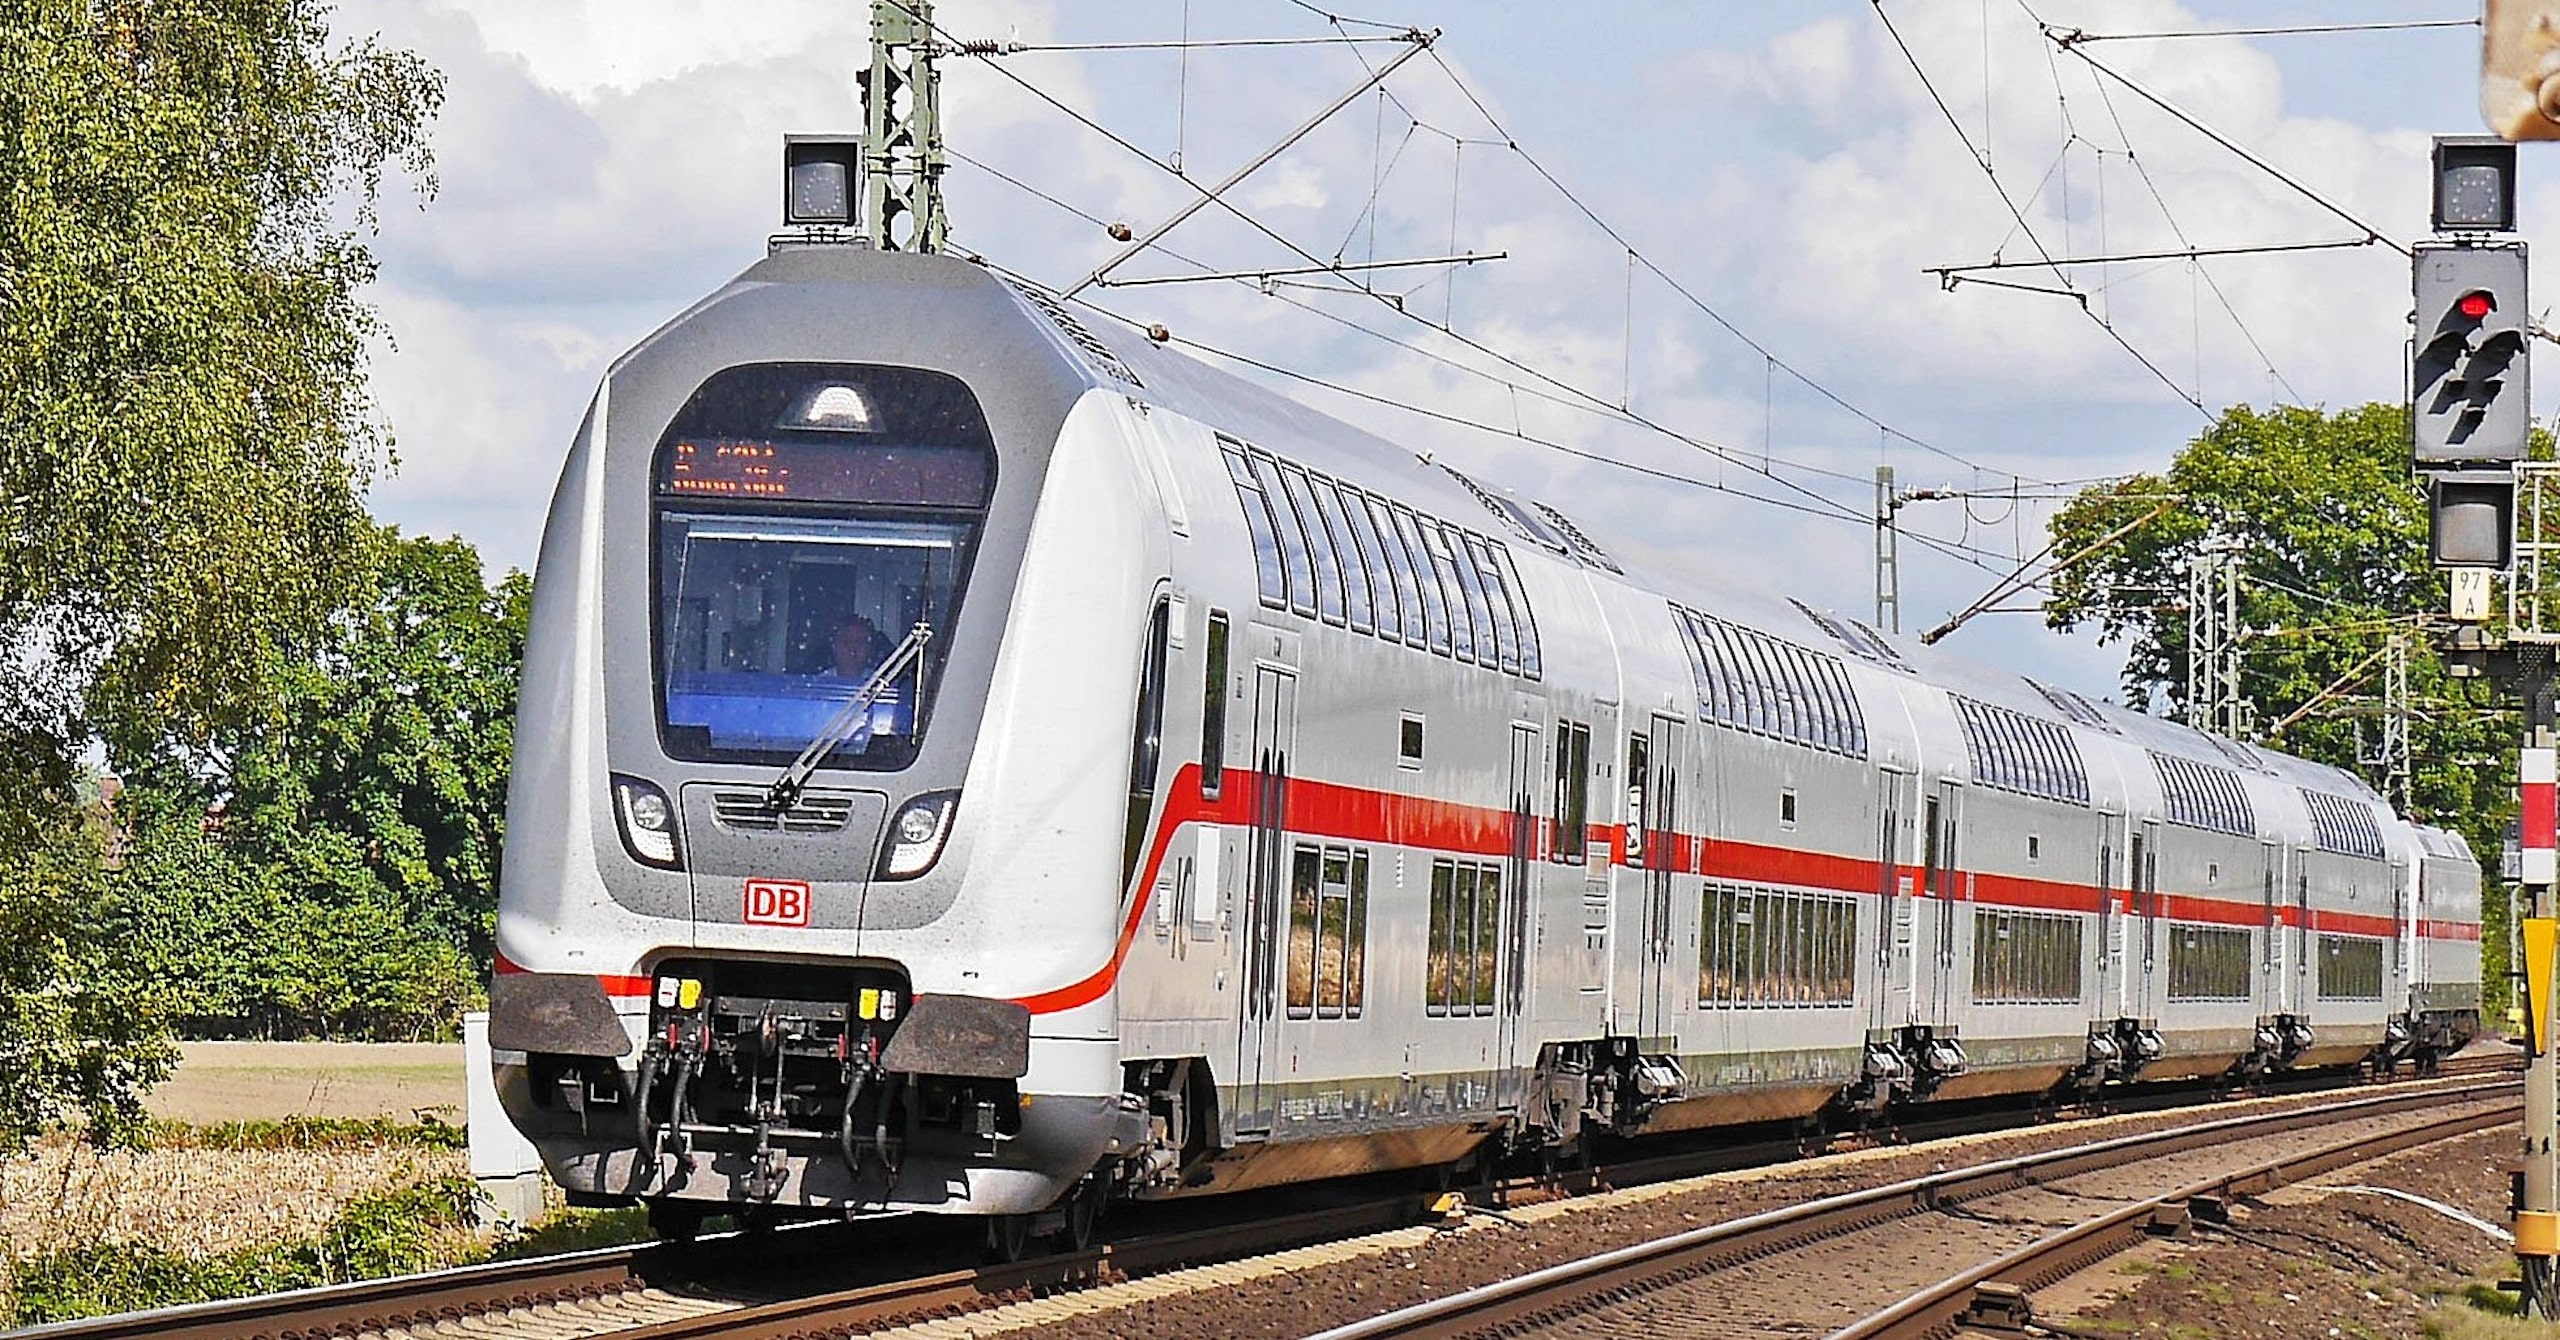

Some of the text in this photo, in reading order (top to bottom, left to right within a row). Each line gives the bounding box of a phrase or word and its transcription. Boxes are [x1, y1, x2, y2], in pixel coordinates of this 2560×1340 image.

[2460, 571, 2481, 590] 97
[2465, 597, 2475, 615] A
[751, 885, 801, 920] DB
